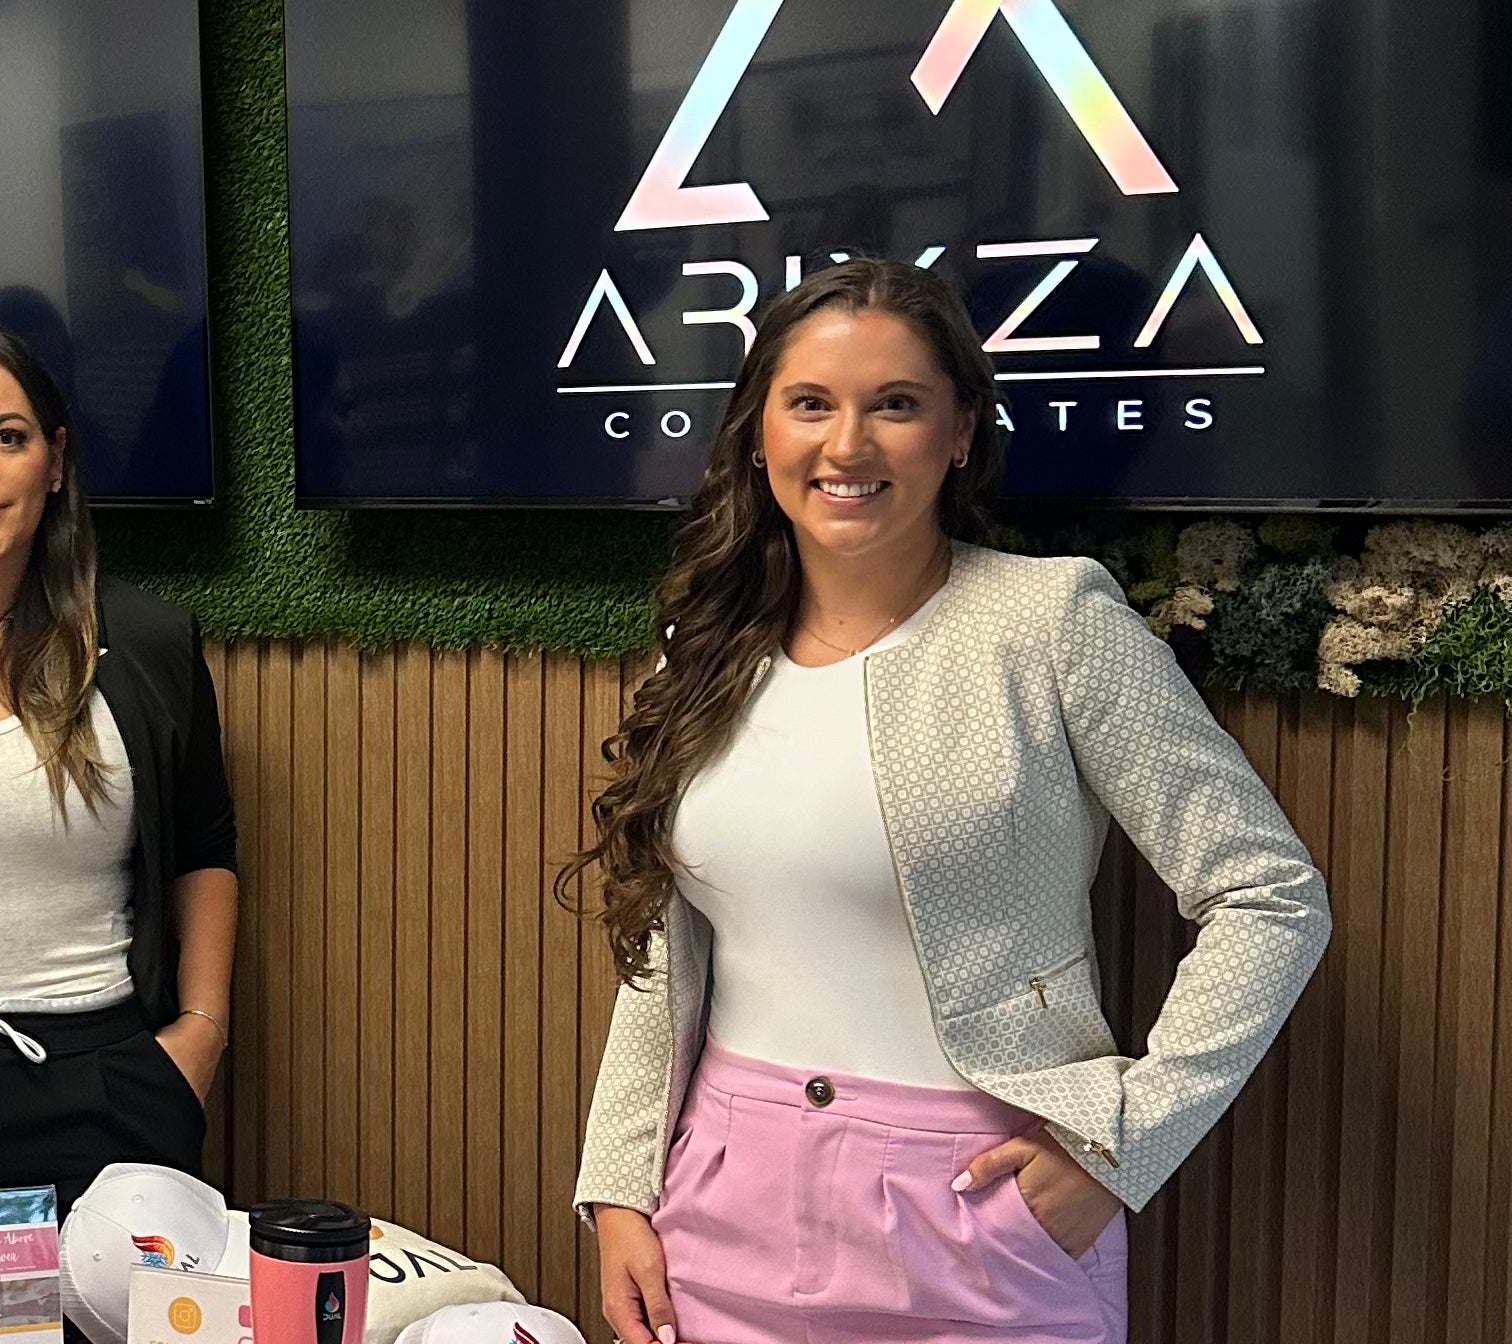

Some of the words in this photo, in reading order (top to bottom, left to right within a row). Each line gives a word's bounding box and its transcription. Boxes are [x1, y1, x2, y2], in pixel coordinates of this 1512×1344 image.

[557, 232, 1264, 369] ARZA
[603, 398, 1215, 439] COATES
[4, 1232, 34, 1245] Above
[369, 1248, 478, 1284] UAL
